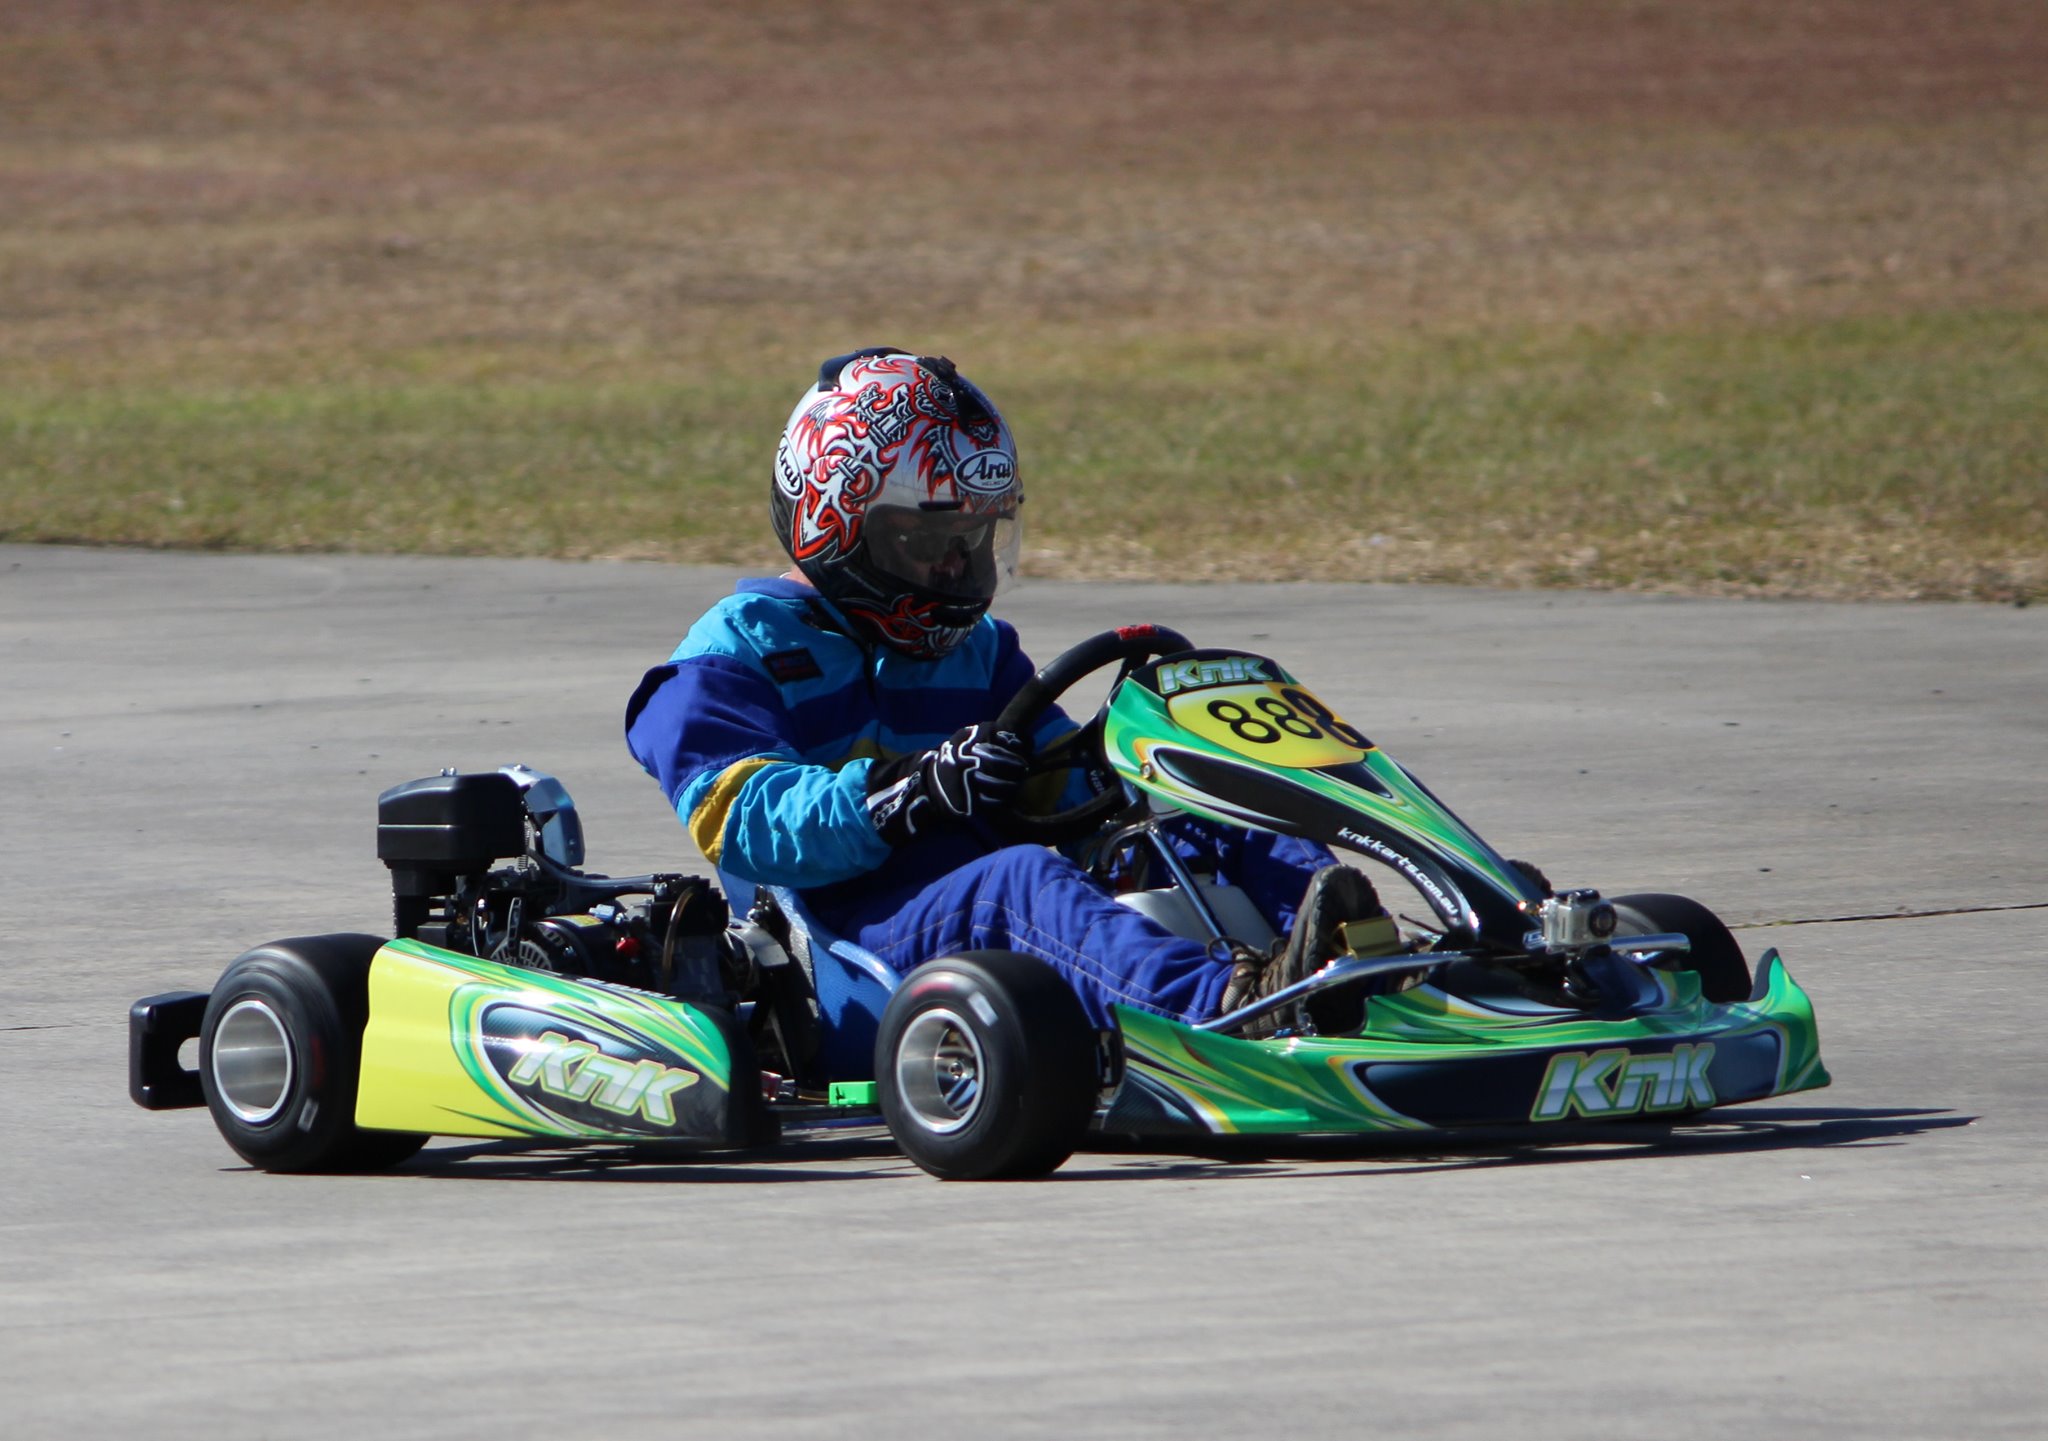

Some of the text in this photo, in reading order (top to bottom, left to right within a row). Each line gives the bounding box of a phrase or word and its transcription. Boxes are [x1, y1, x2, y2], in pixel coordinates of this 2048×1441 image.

[779, 444, 800, 487] Arai
[963, 455, 1011, 480] Arai
[1207, 688, 1374, 749] 888
[1337, 827, 1458, 915] knkkarts.com.au
